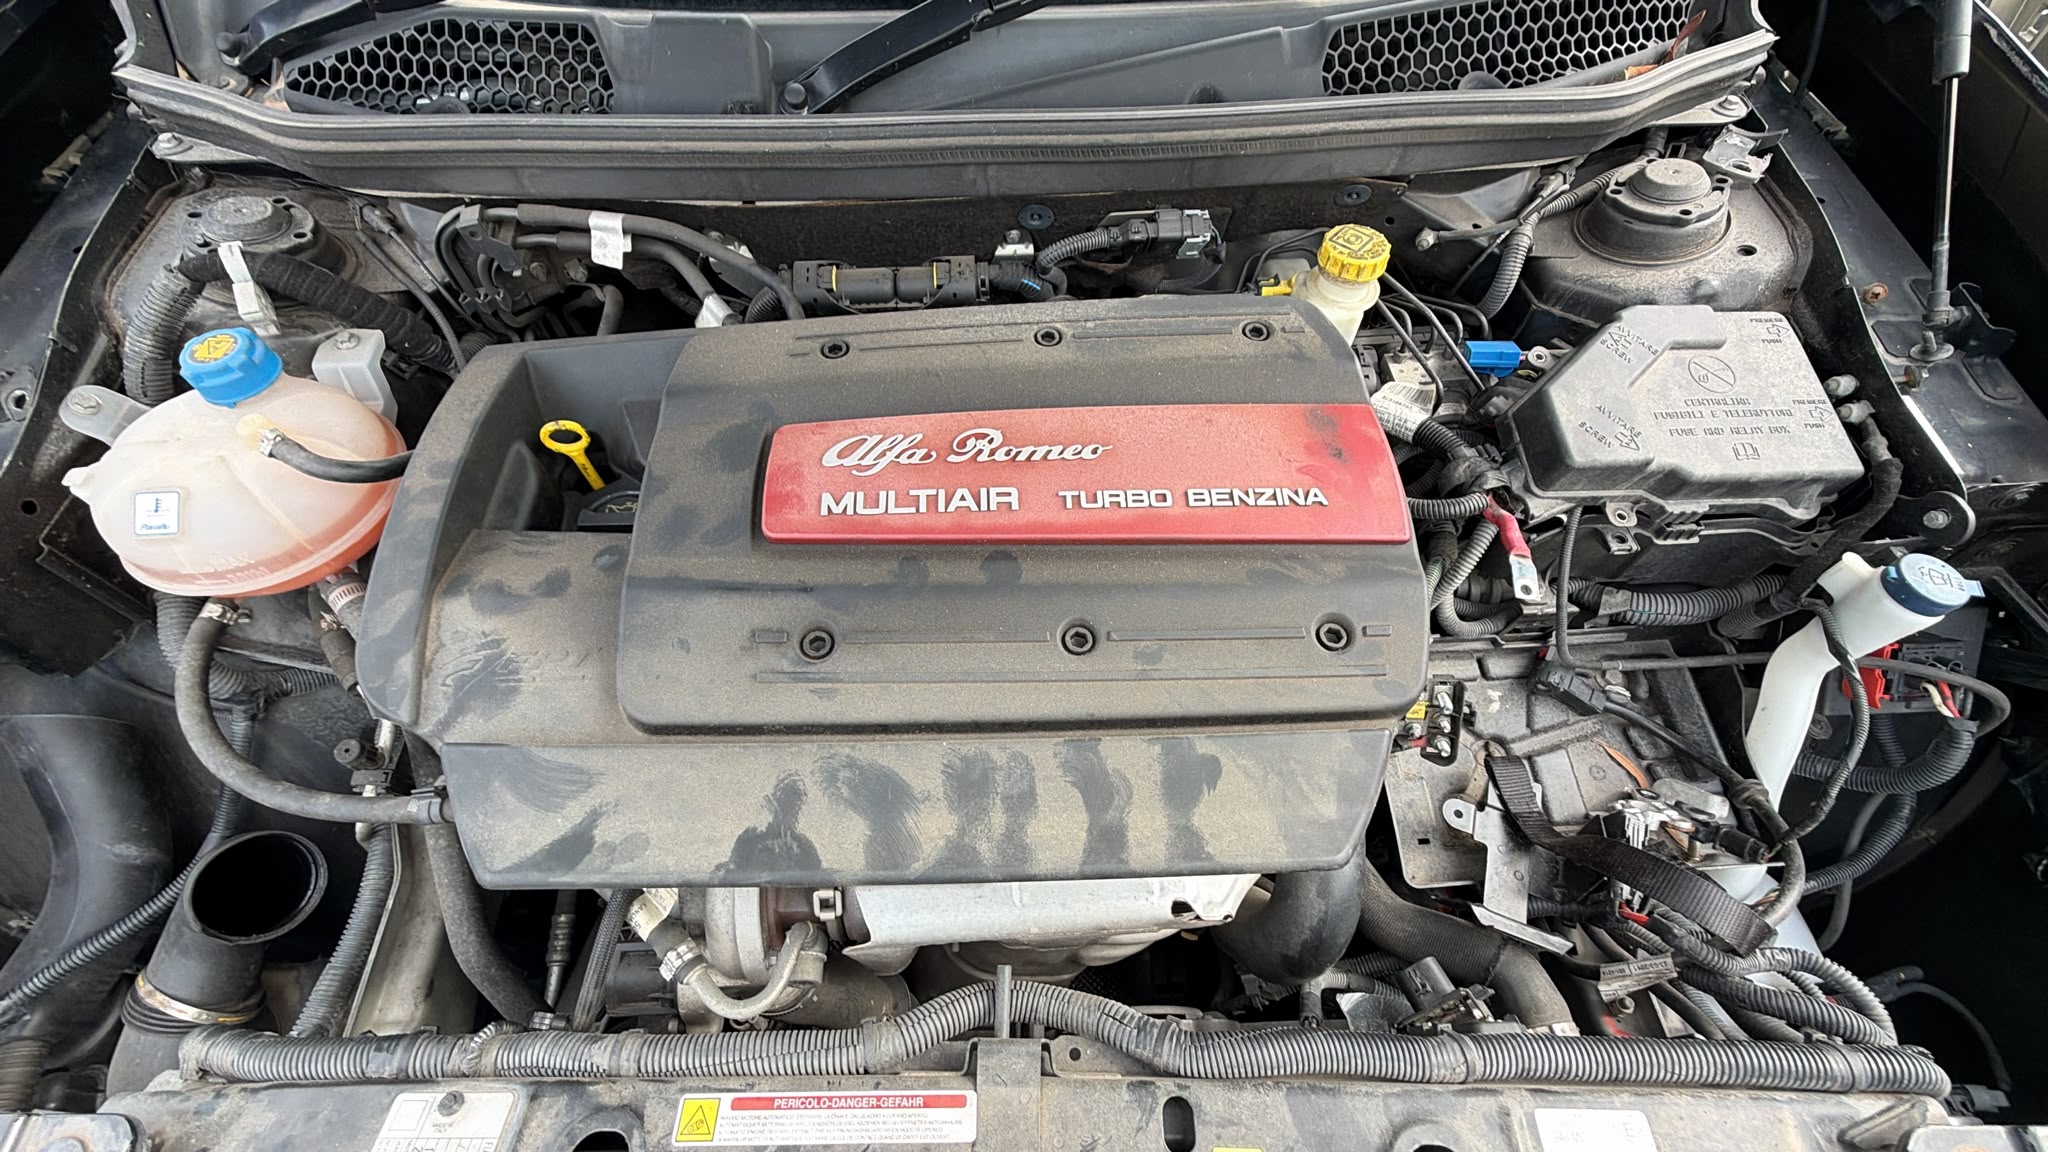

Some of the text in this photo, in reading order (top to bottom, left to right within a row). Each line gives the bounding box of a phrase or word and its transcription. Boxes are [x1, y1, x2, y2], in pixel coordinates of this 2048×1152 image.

[1668, 427, 1699, 437] FUSE
[1768, 423, 1792, 435] BOX
[822, 428, 1114, 477] Alfa Romeo
[820, 486, 1329, 516] MULTIAIR TURBO BENZINA
[773, 1096, 924, 1109] PERICOLO-DANGER-GEFAHR
